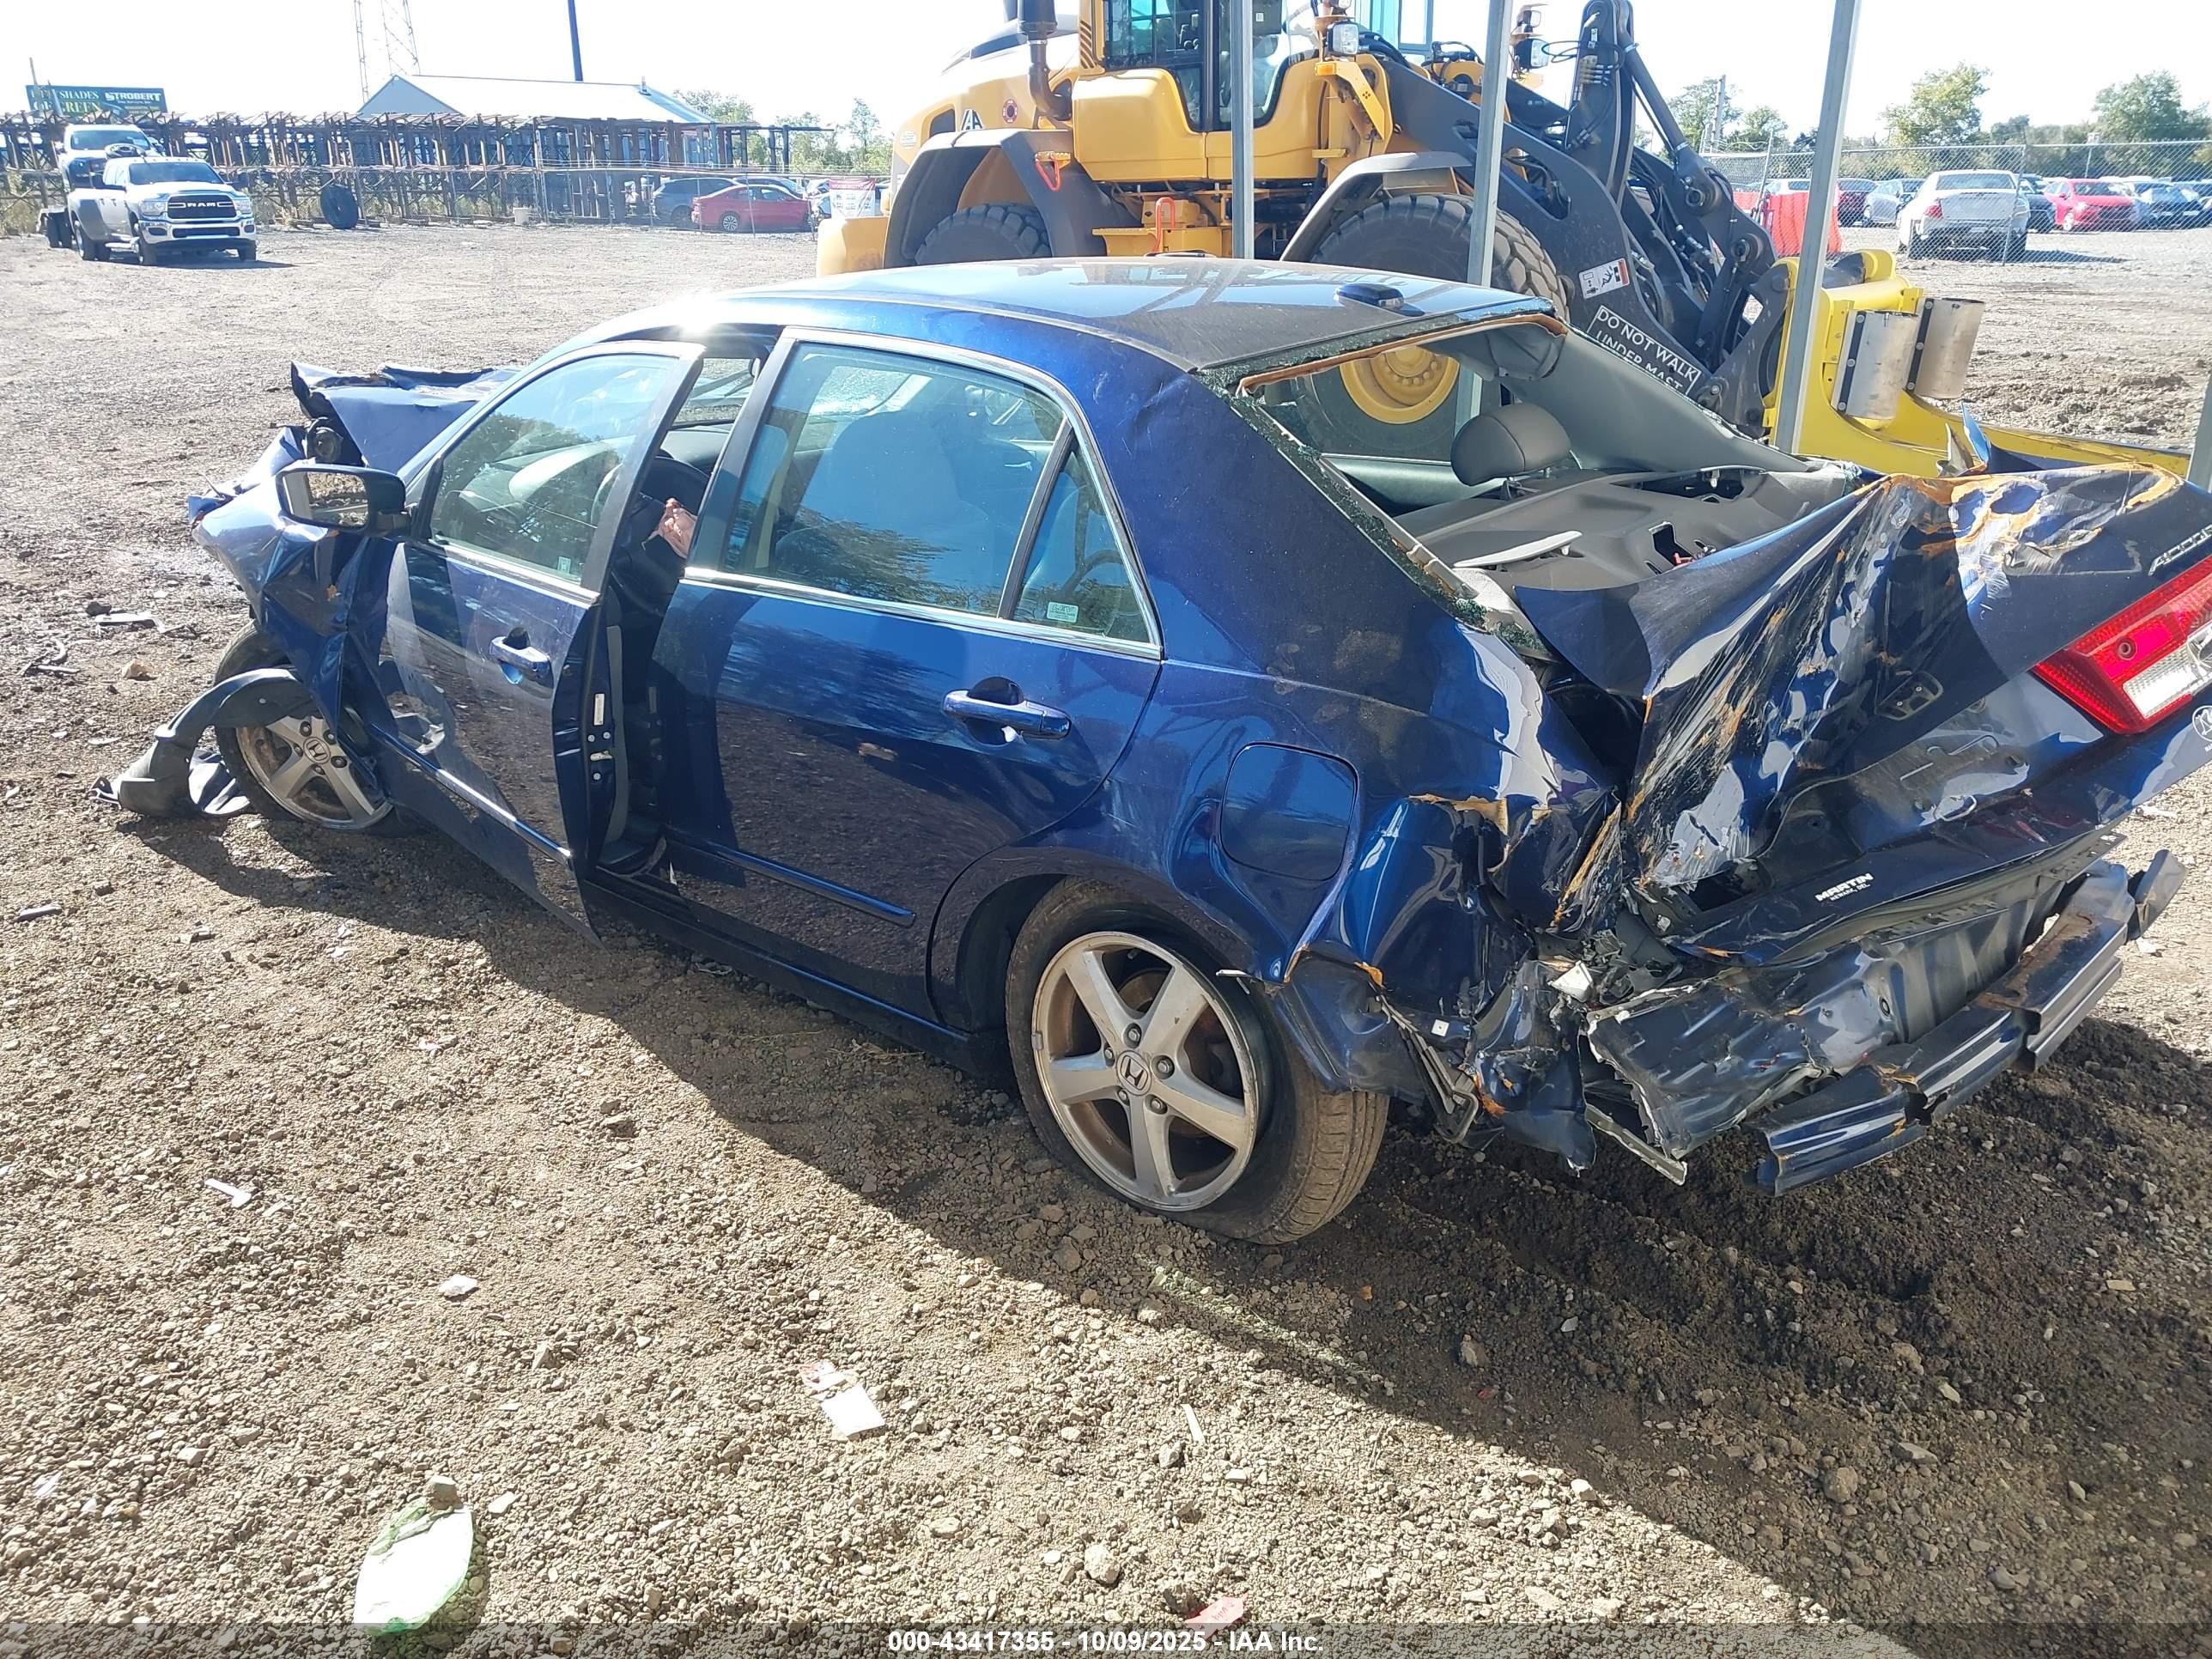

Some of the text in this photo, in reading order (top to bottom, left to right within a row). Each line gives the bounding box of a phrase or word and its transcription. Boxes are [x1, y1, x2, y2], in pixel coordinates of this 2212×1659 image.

[59, 90, 100, 100] SHADES
[105, 91, 161, 101] STROBERT
[1597, 307, 1699, 382] DO NOT WALK
[1814, 872, 1874, 902] MARTIN
